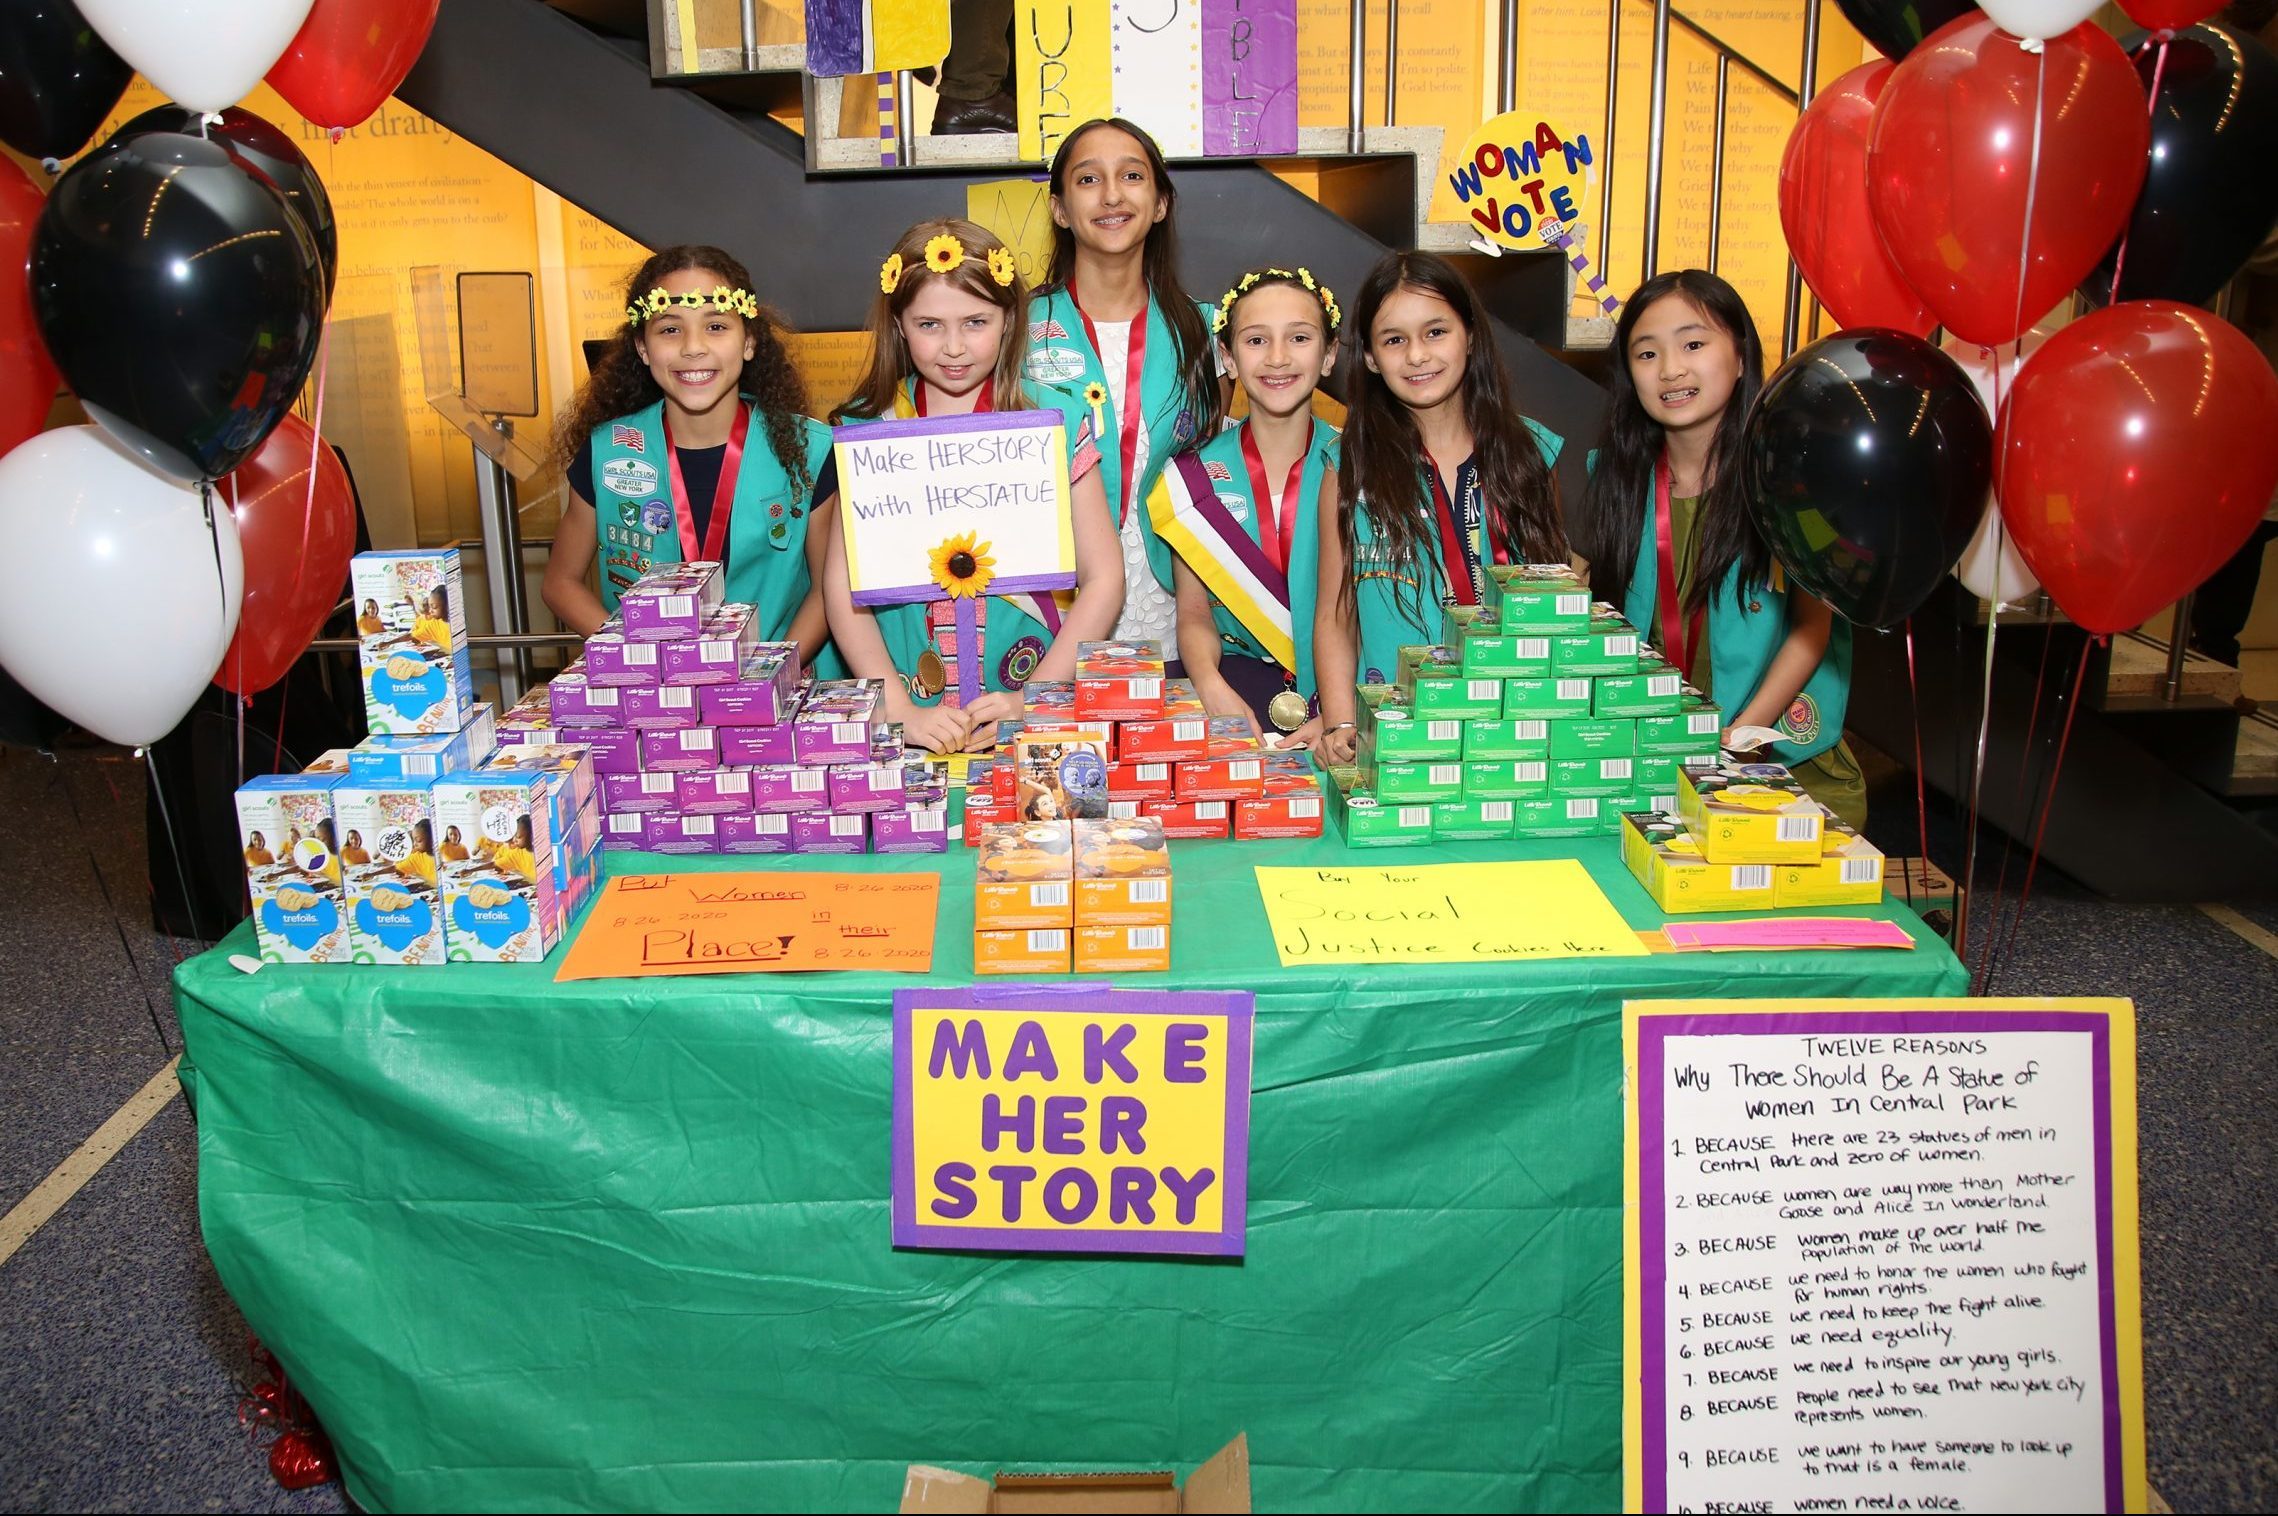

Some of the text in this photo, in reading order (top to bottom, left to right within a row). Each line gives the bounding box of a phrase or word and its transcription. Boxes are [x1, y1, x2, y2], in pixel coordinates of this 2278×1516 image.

[1450, 122, 1593, 203] WOMAN
[1471, 179, 1578, 238] VOTE
[1539, 221, 1563, 239] VOTE
[852, 432, 1051, 476] Make HERSTORY
[852, 480, 1055, 520] with HERSTATUE
[618, 875, 676, 890] Put
[1380, 872, 1420, 883] Your
[688, 887, 807, 902] Women
[1279, 888, 1460, 921] Social
[811, 911, 831, 921] in
[839, 925, 897, 936] their
[1285, 927, 1447, 955] Justice
[1563, 941, 1612, 953] Here
[642, 929, 796, 960] Place!
[928, 1018, 1209, 1085] MAKE
[1801, 1037, 1987, 1058] TWELVE REASONS
[1674, 1060, 2039, 1092] Why There Should Be A Statue of
[1831, 1097, 1861, 1114] In
[1870, 1093, 1944, 1112] Central
[1963, 1093, 2018, 1115] Park
[981, 1093, 1148, 1155] HER
[1695, 1135, 1775, 1155] BECAUSE
[1792, 1131, 1834, 1148] there
[1843, 1132, 1868, 1145] are
[1876, 1131, 1900, 1144] 23
[1909, 1131, 1970, 1144] statues
[1975, 1126, 1991, 1142] of
[1996, 1127, 2032, 1141] men
[2039, 1126, 2056, 1141] in
[1700, 1156, 1760, 1174] Central
[1810, 1151, 1839, 1167] and
[1848, 1151, 1884, 1165] zero
[1890, 1148, 1911, 1162] of
[1919, 1149, 1985, 1161] women.
[930, 1161, 1216, 1226] STORY
[1675, 1173, 2075, 1209] 2. BECAUSE women are way more than Mother
[1834, 1201, 1864, 1216] and
[1874, 1200, 1914, 1214] Alice
[1923, 1199, 1945, 1212] In
[1859, 1228, 1899, 1241] make
[1908, 1227, 1926, 1241] up
[1933, 1224, 1967, 1237] over
[1976, 1220, 2009, 1234] half
[1674, 1235, 1777, 1257] 3. BECAUSE
[1801, 1243, 1875, 1262] population
[1885, 1242, 1901, 1253] of
[1910, 1241, 1933, 1253] the
[1679, 1294, 2046, 1332] 5. BECAUSE we need to keep the fight alive.
[1679, 1344, 1695, 1359] 6.
[1703, 1335, 1775, 1357] BECAUSE
[1791, 1333, 1812, 1345] we
[1821, 1328, 1862, 1343] need
[1682, 1348, 2062, 1387] 7. BECAUSE we need to inspire our young girls.
[1848, 1380, 1884, 1399] need
[1890, 1381, 1907, 1395] to
[1913, 1383, 1941, 1395] see
[1990, 1378, 2019, 1391] New
[1679, 1396, 1779, 1421] 8. BECAUSE
[1794, 1405, 1927, 1426] represents women.
[1705, 1493, 1965, 1514] BECAUSE women need a voice.
